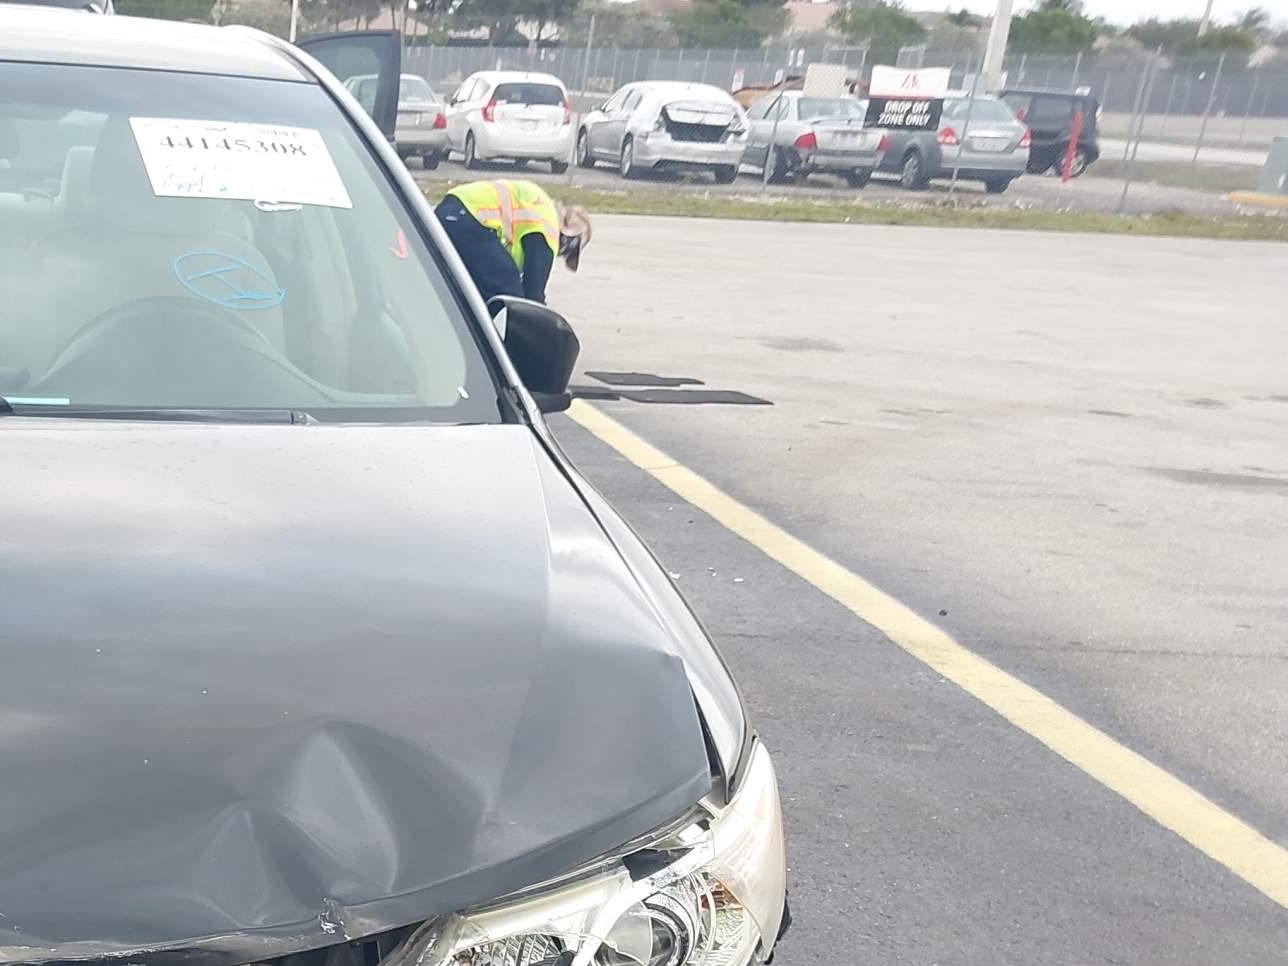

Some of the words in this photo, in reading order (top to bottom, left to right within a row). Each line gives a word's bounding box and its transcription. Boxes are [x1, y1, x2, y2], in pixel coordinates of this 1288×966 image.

[884, 100, 912, 113] DROP
[911, 101, 930, 113] OFF
[878, 113, 905, 125] ZONE
[905, 113, 931, 126] ONLY
[160, 135, 307, 157] 44145308
